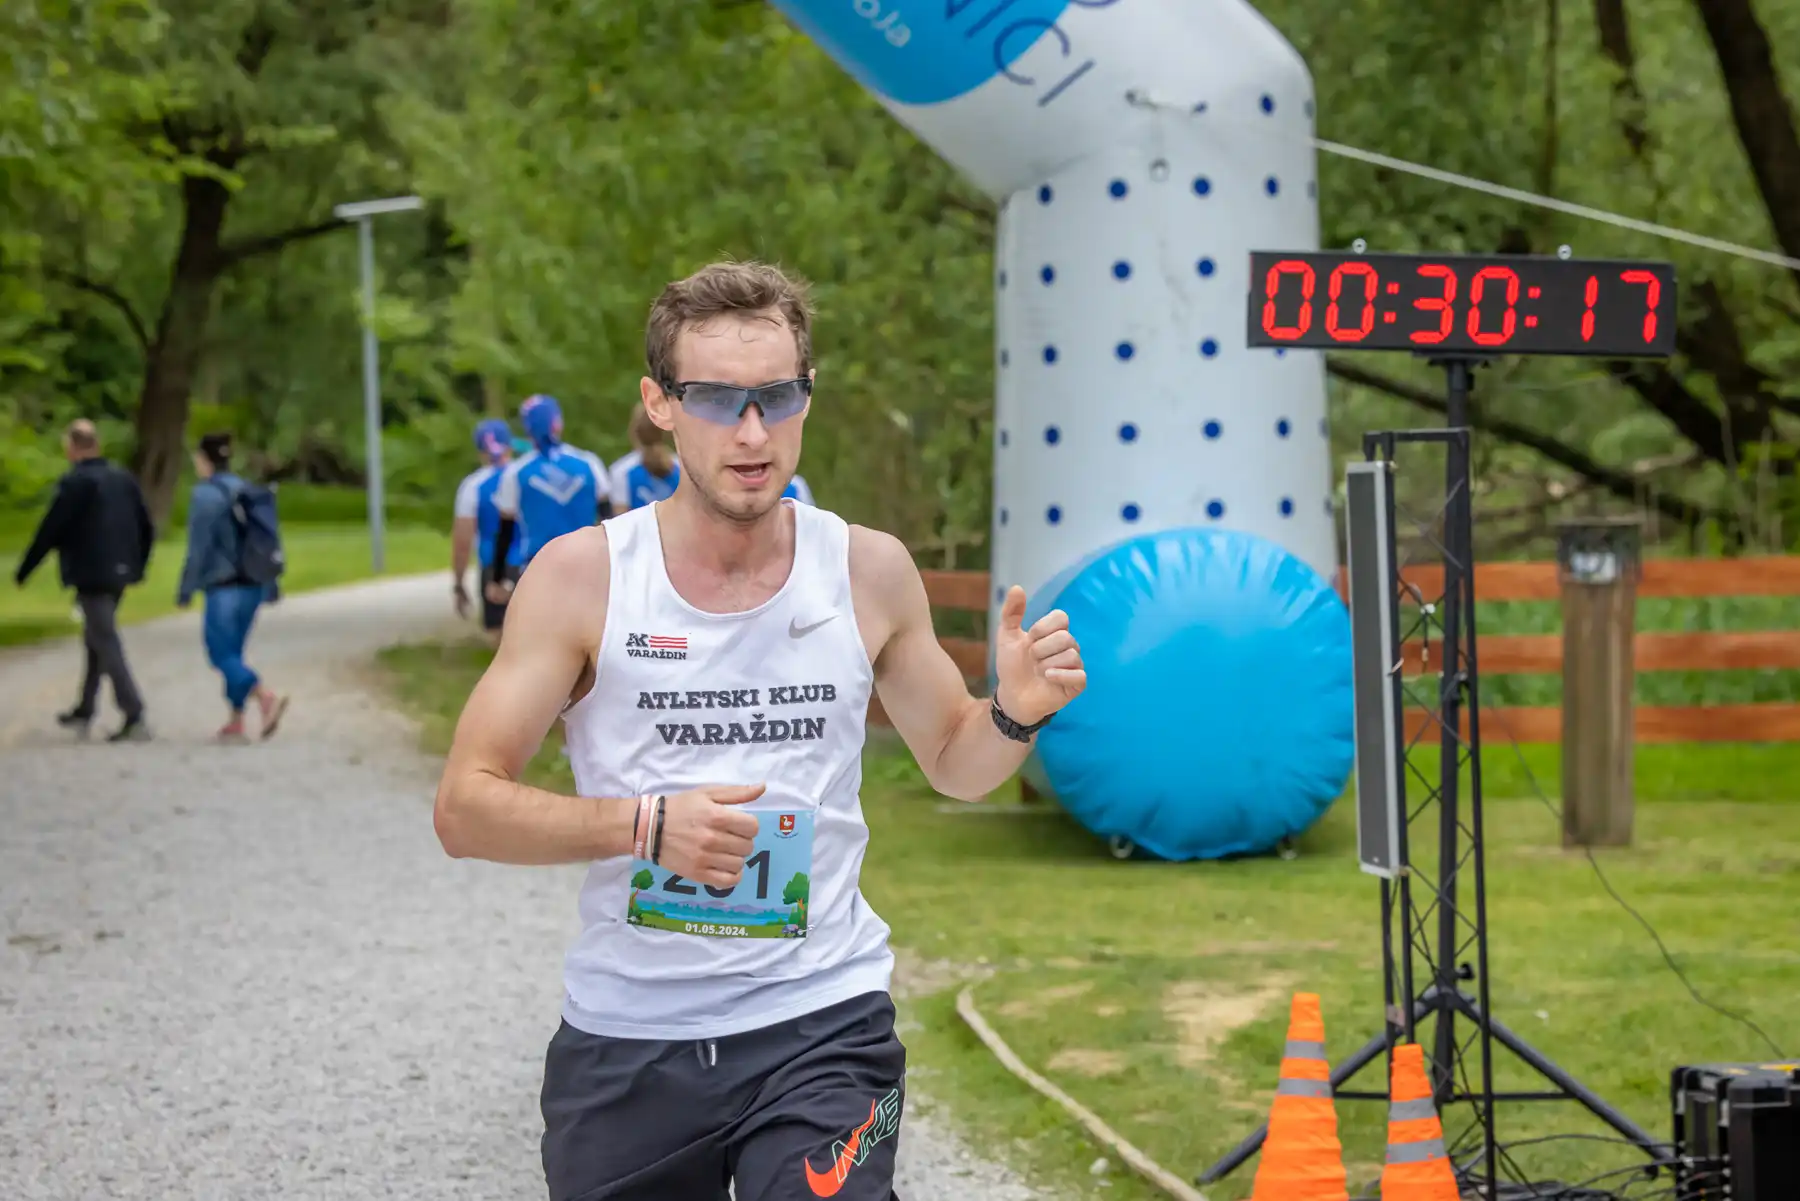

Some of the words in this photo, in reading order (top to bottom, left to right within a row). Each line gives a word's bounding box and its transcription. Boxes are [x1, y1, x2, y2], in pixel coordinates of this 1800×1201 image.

[627, 649, 687, 660] VARAŽDIN
[637, 689, 760, 709] ATLETSKI
[769, 684, 837, 704] KLUB
[656, 714, 826, 745] VARAŽDIN
[685, 922, 749, 936] 01.05.2024.
